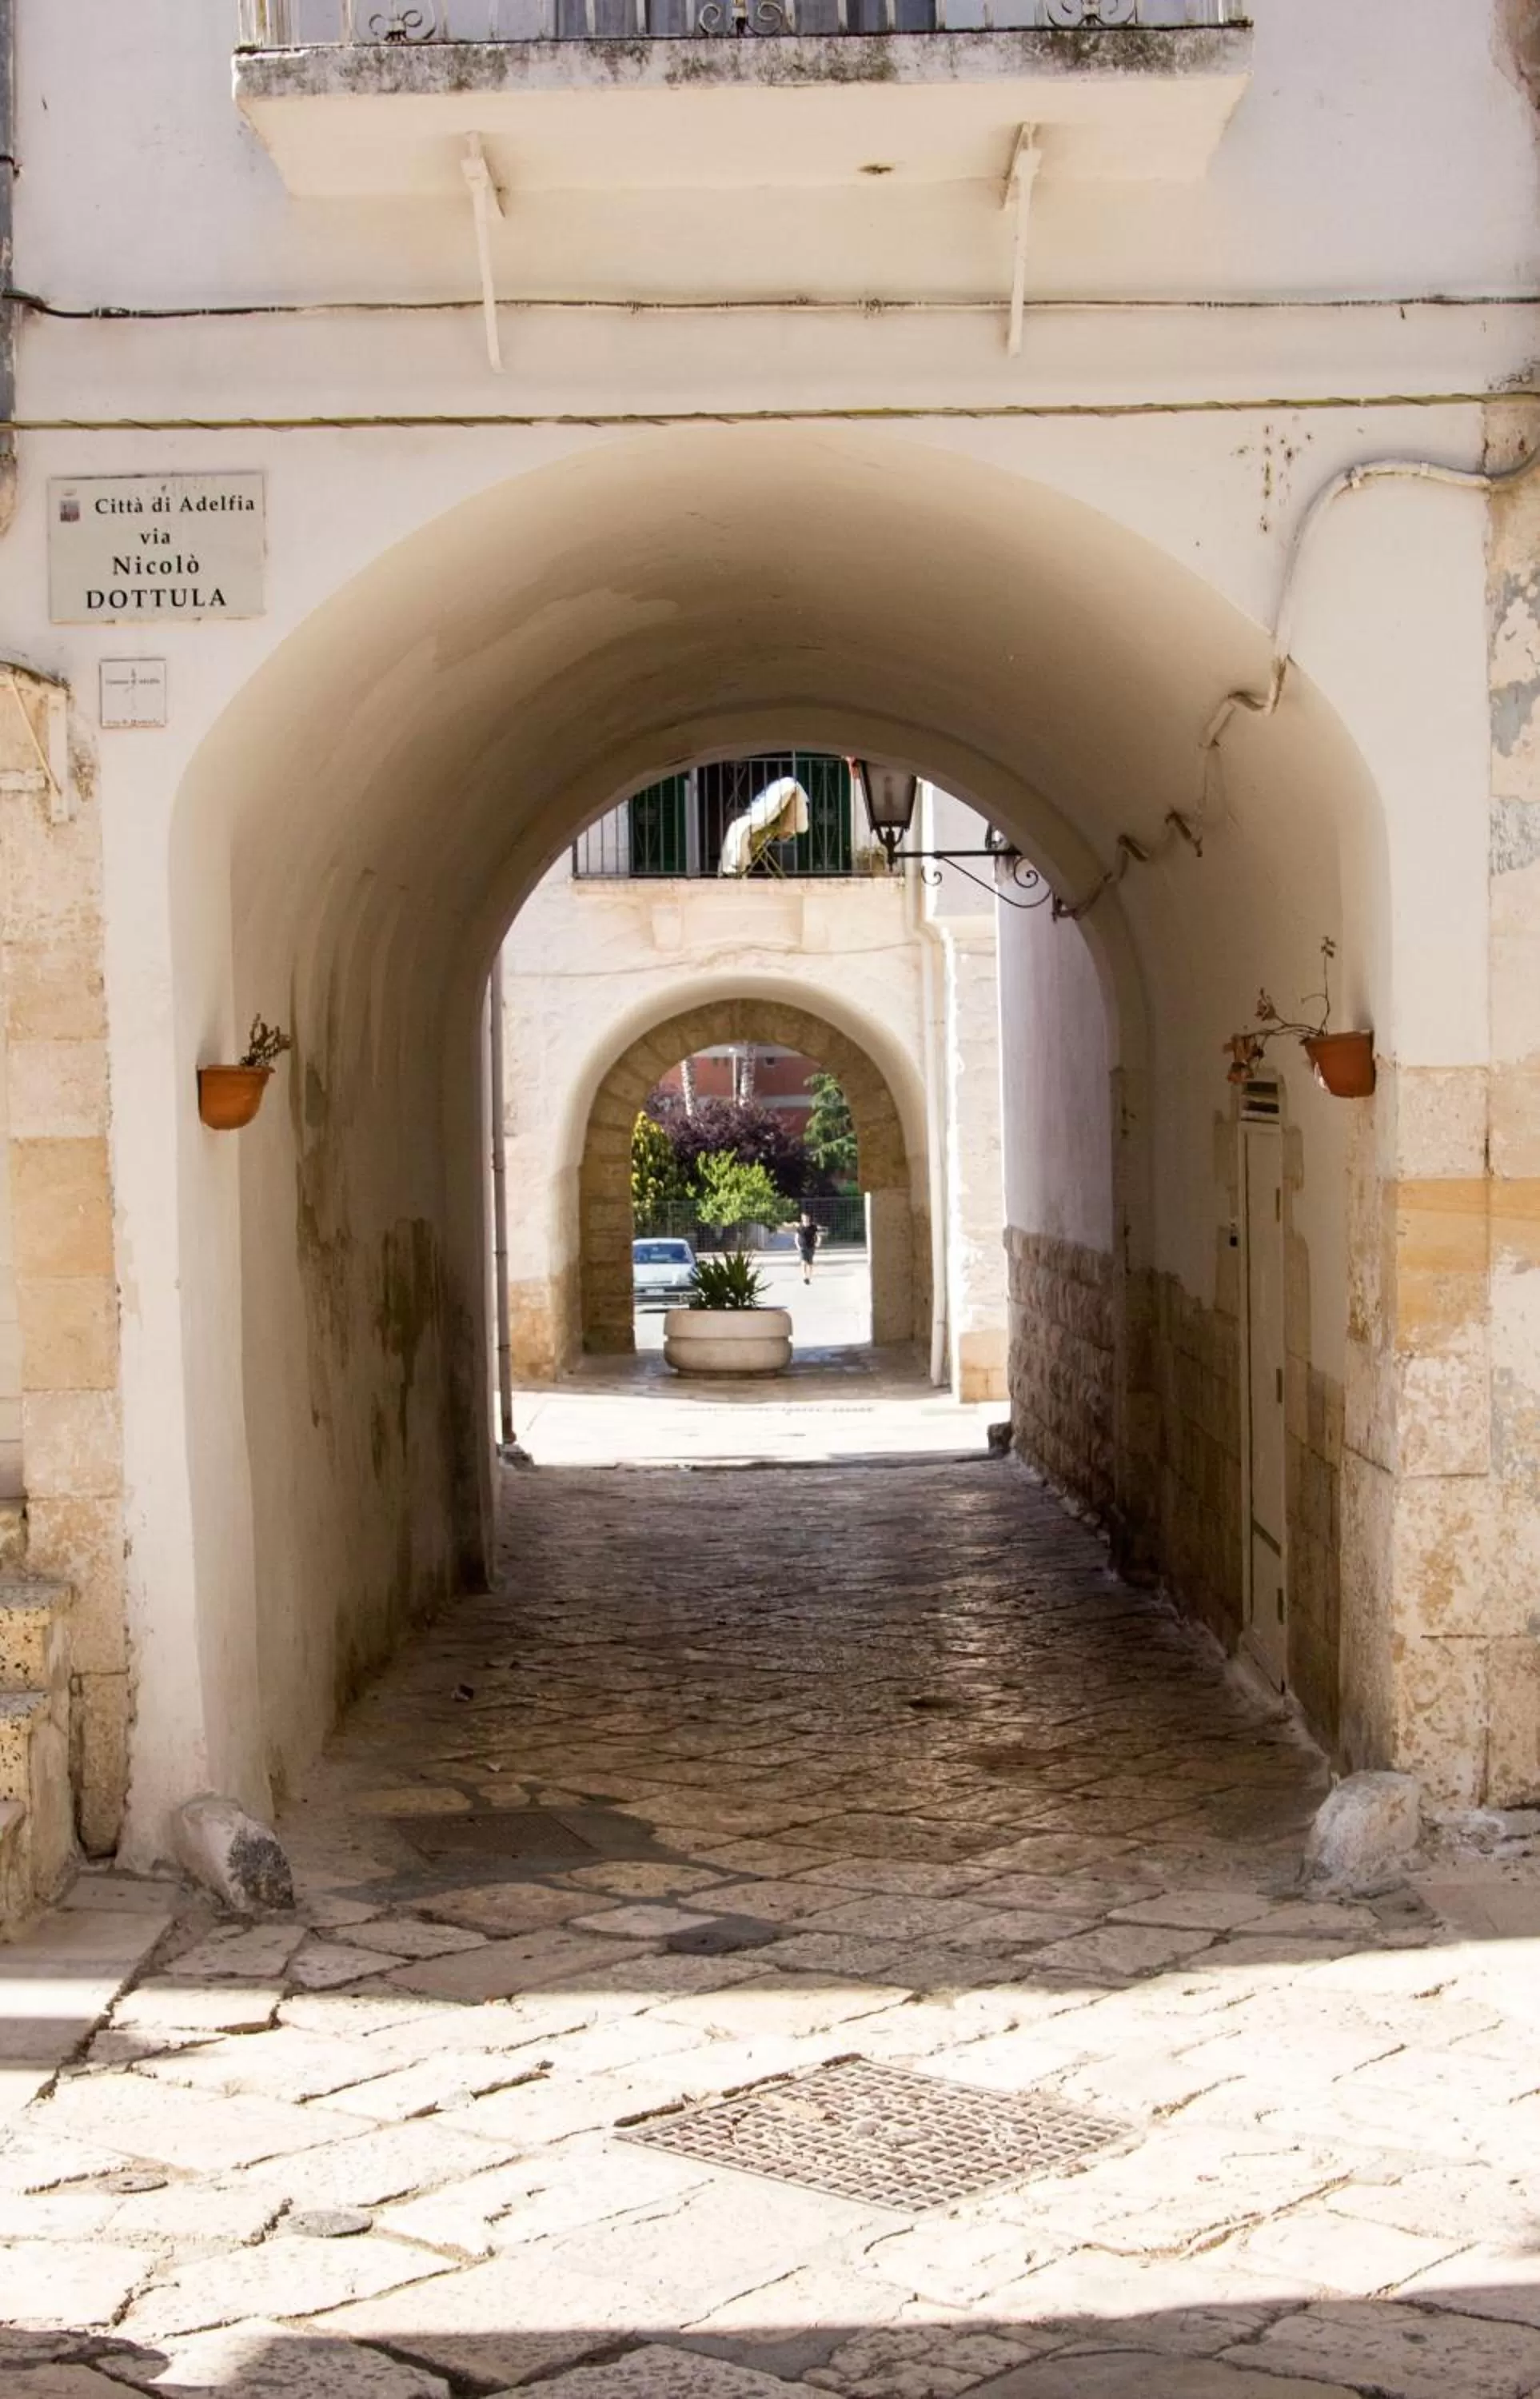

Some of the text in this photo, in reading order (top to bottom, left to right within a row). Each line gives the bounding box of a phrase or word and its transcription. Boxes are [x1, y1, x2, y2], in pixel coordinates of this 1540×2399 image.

[94, 494, 255, 515] Città di Adelfia
[139, 527, 171, 545] via
[112, 554, 200, 576] Nicolò
[86, 588, 227, 609] DOTTULA
